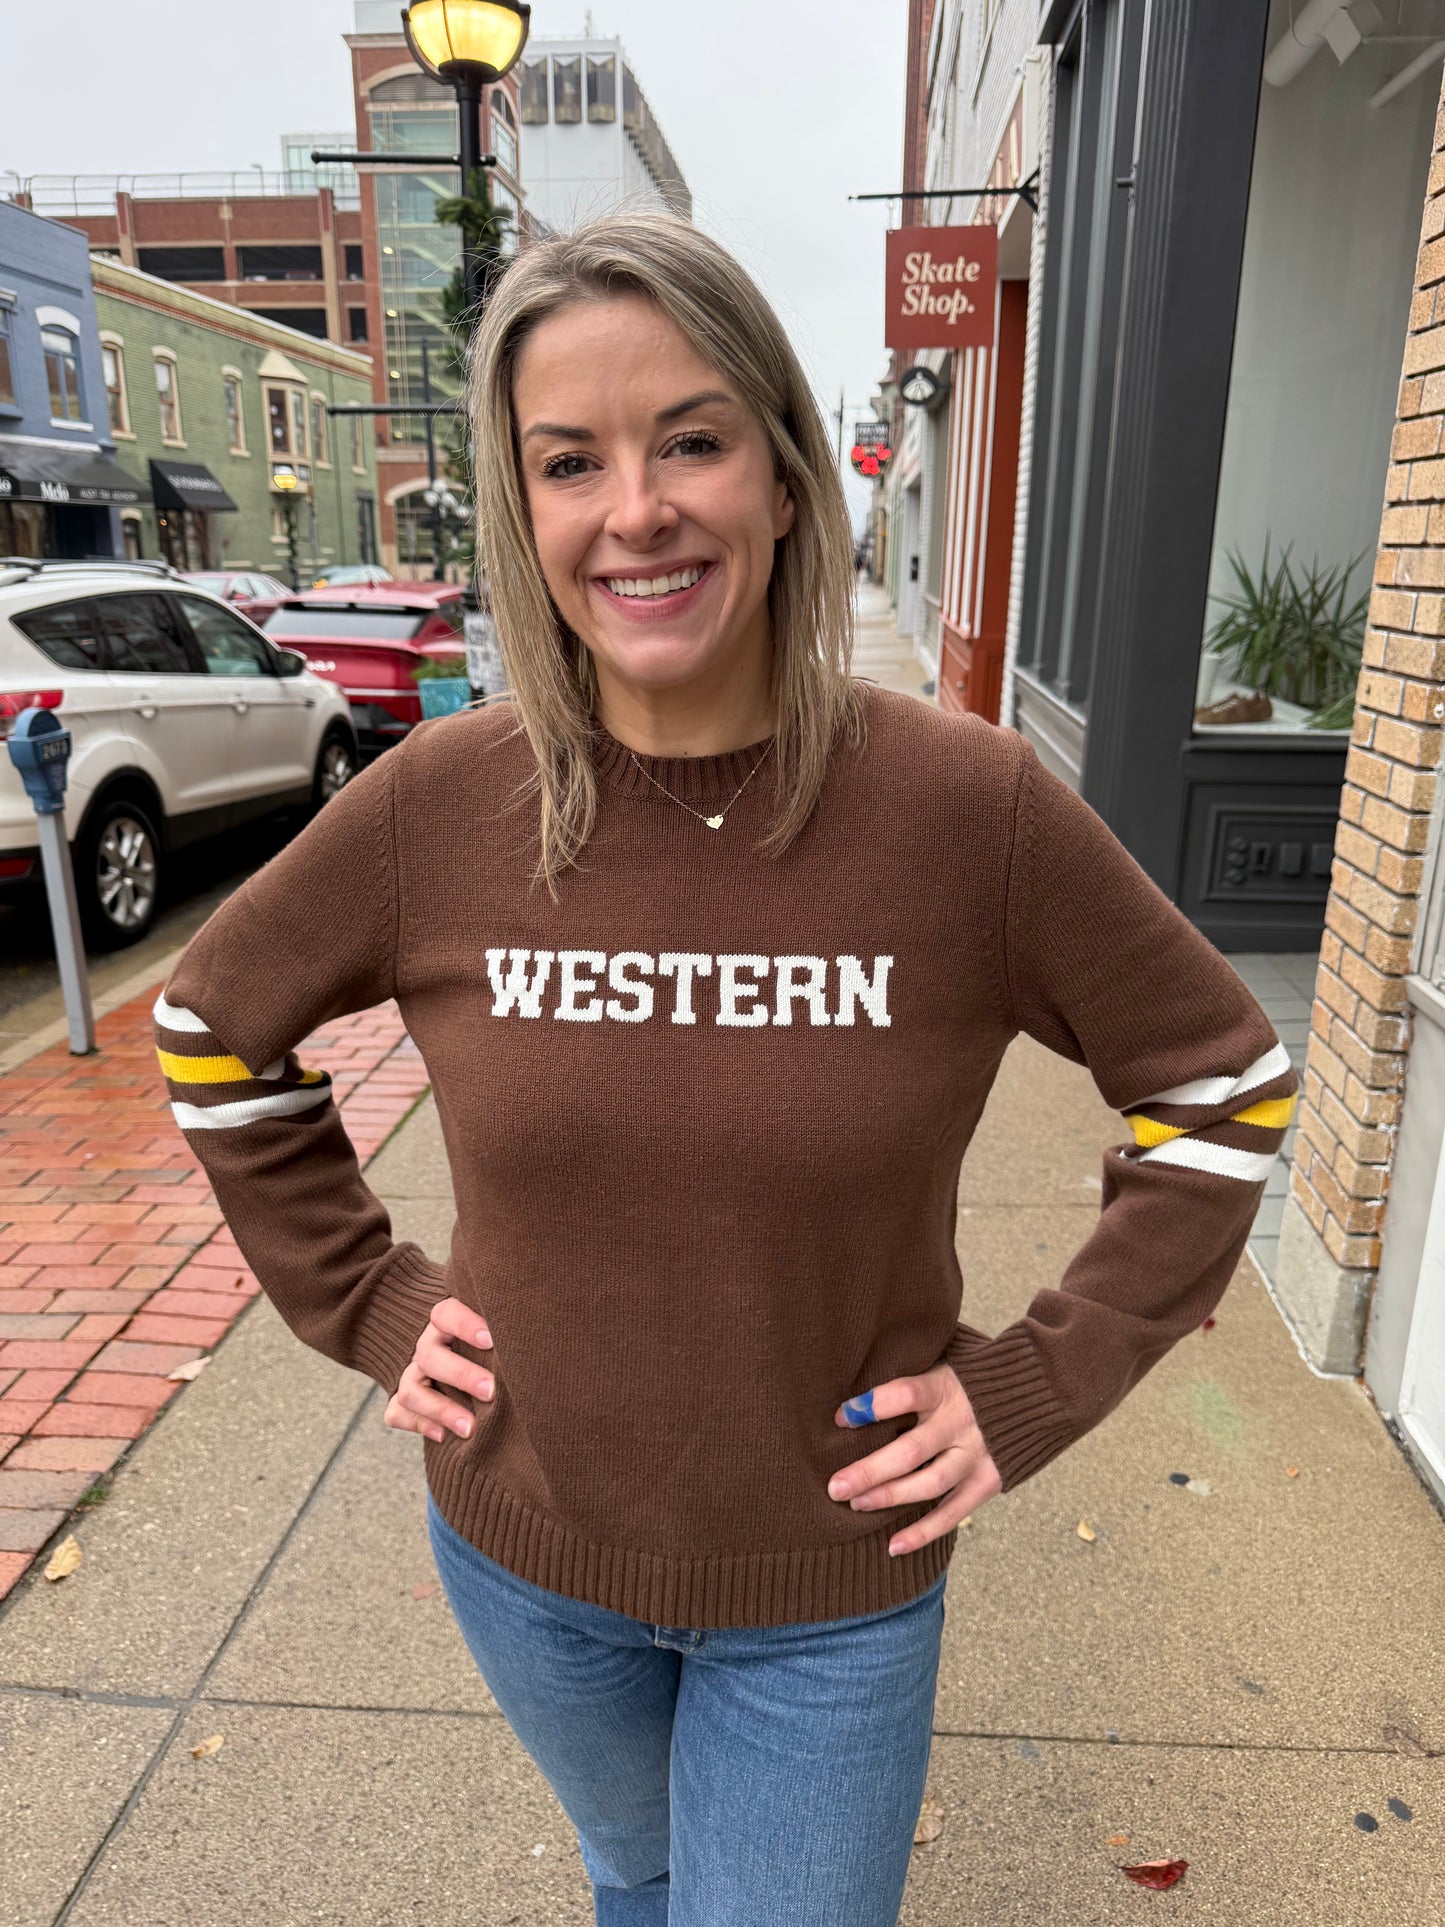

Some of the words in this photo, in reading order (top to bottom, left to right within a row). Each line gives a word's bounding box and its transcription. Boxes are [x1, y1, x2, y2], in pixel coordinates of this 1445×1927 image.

[901, 251, 980, 284] Skate
[901, 283, 975, 325] Shop.
[485, 948, 894, 1027] WESTERN
